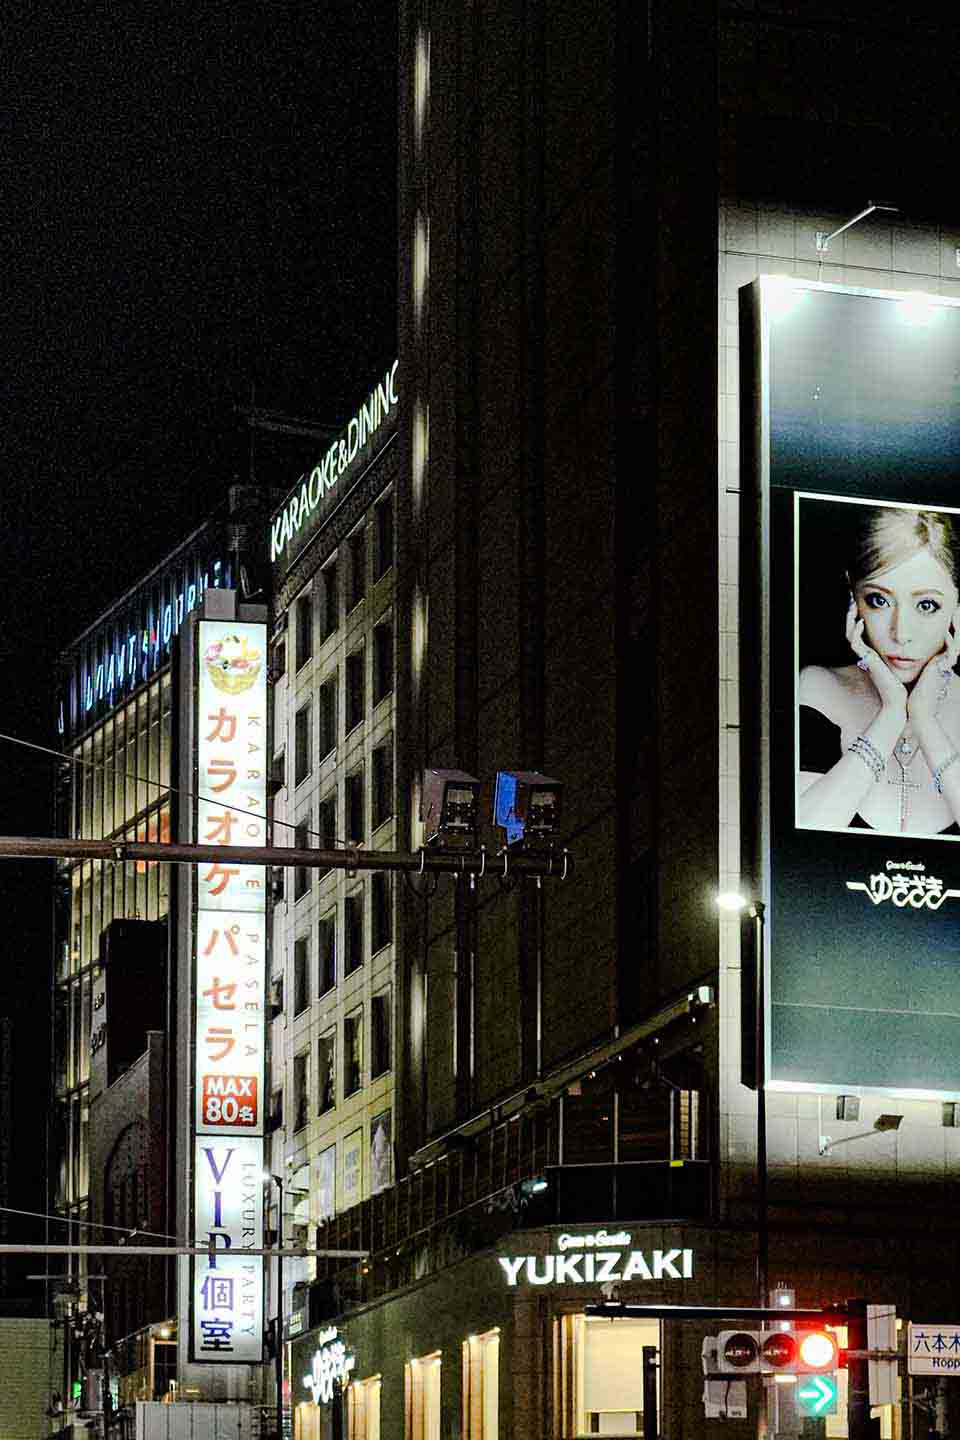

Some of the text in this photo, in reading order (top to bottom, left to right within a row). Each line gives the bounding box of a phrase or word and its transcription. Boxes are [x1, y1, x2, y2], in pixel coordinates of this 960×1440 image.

[205, 707, 241, 896] カラオケ
[246, 716, 261, 888] KARAOE
[202, 924, 240, 1062] パセラ
[244, 932, 259, 1057] PASELA
[206, 1097, 254, 1123] 80名
[207, 1077, 252, 1097] MAX
[242, 1264, 257, 1337] PARTY
[498, 1249, 693, 1286] YUKIZAKI
